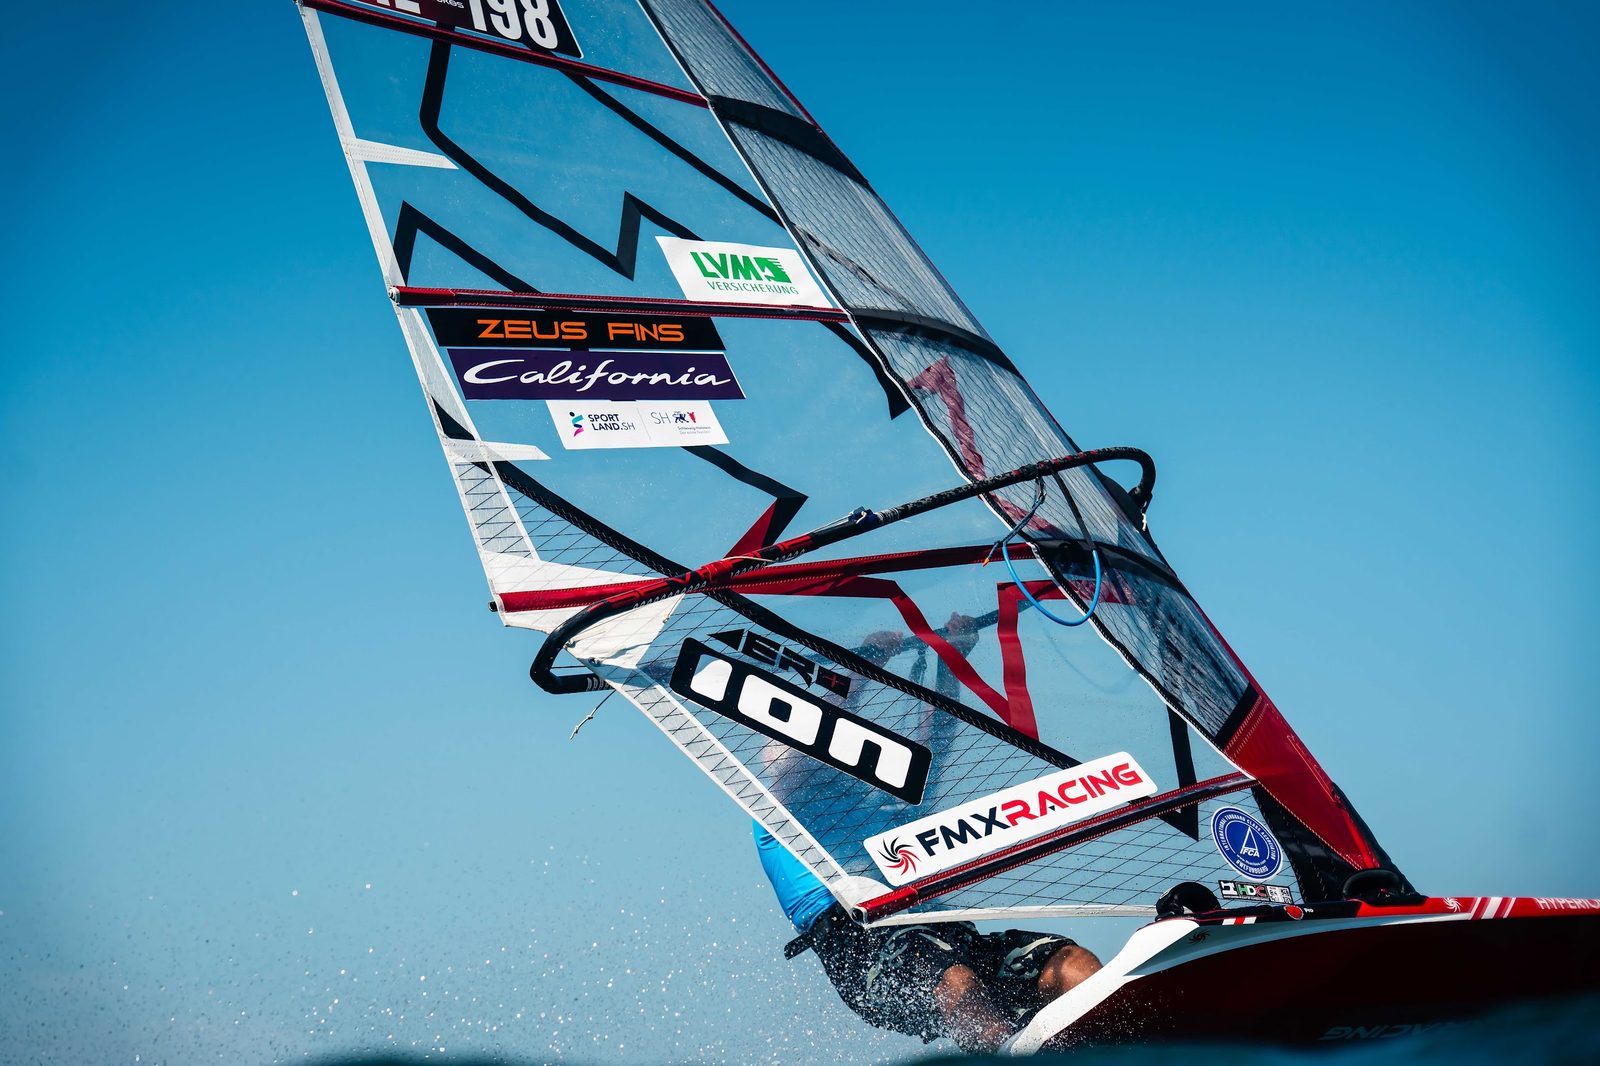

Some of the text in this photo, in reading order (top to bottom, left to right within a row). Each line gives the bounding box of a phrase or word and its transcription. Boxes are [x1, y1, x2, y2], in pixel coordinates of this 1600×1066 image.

[469, 0, 558, 50] 198
[690, 252, 764, 281] LVM
[707, 281, 799, 295] VERSICHERUNG
[477, 319, 685, 342] ZEUS FINS
[463, 359, 731, 392] California
[588, 413, 619, 422] SPORT
[650, 411, 671, 424] SH
